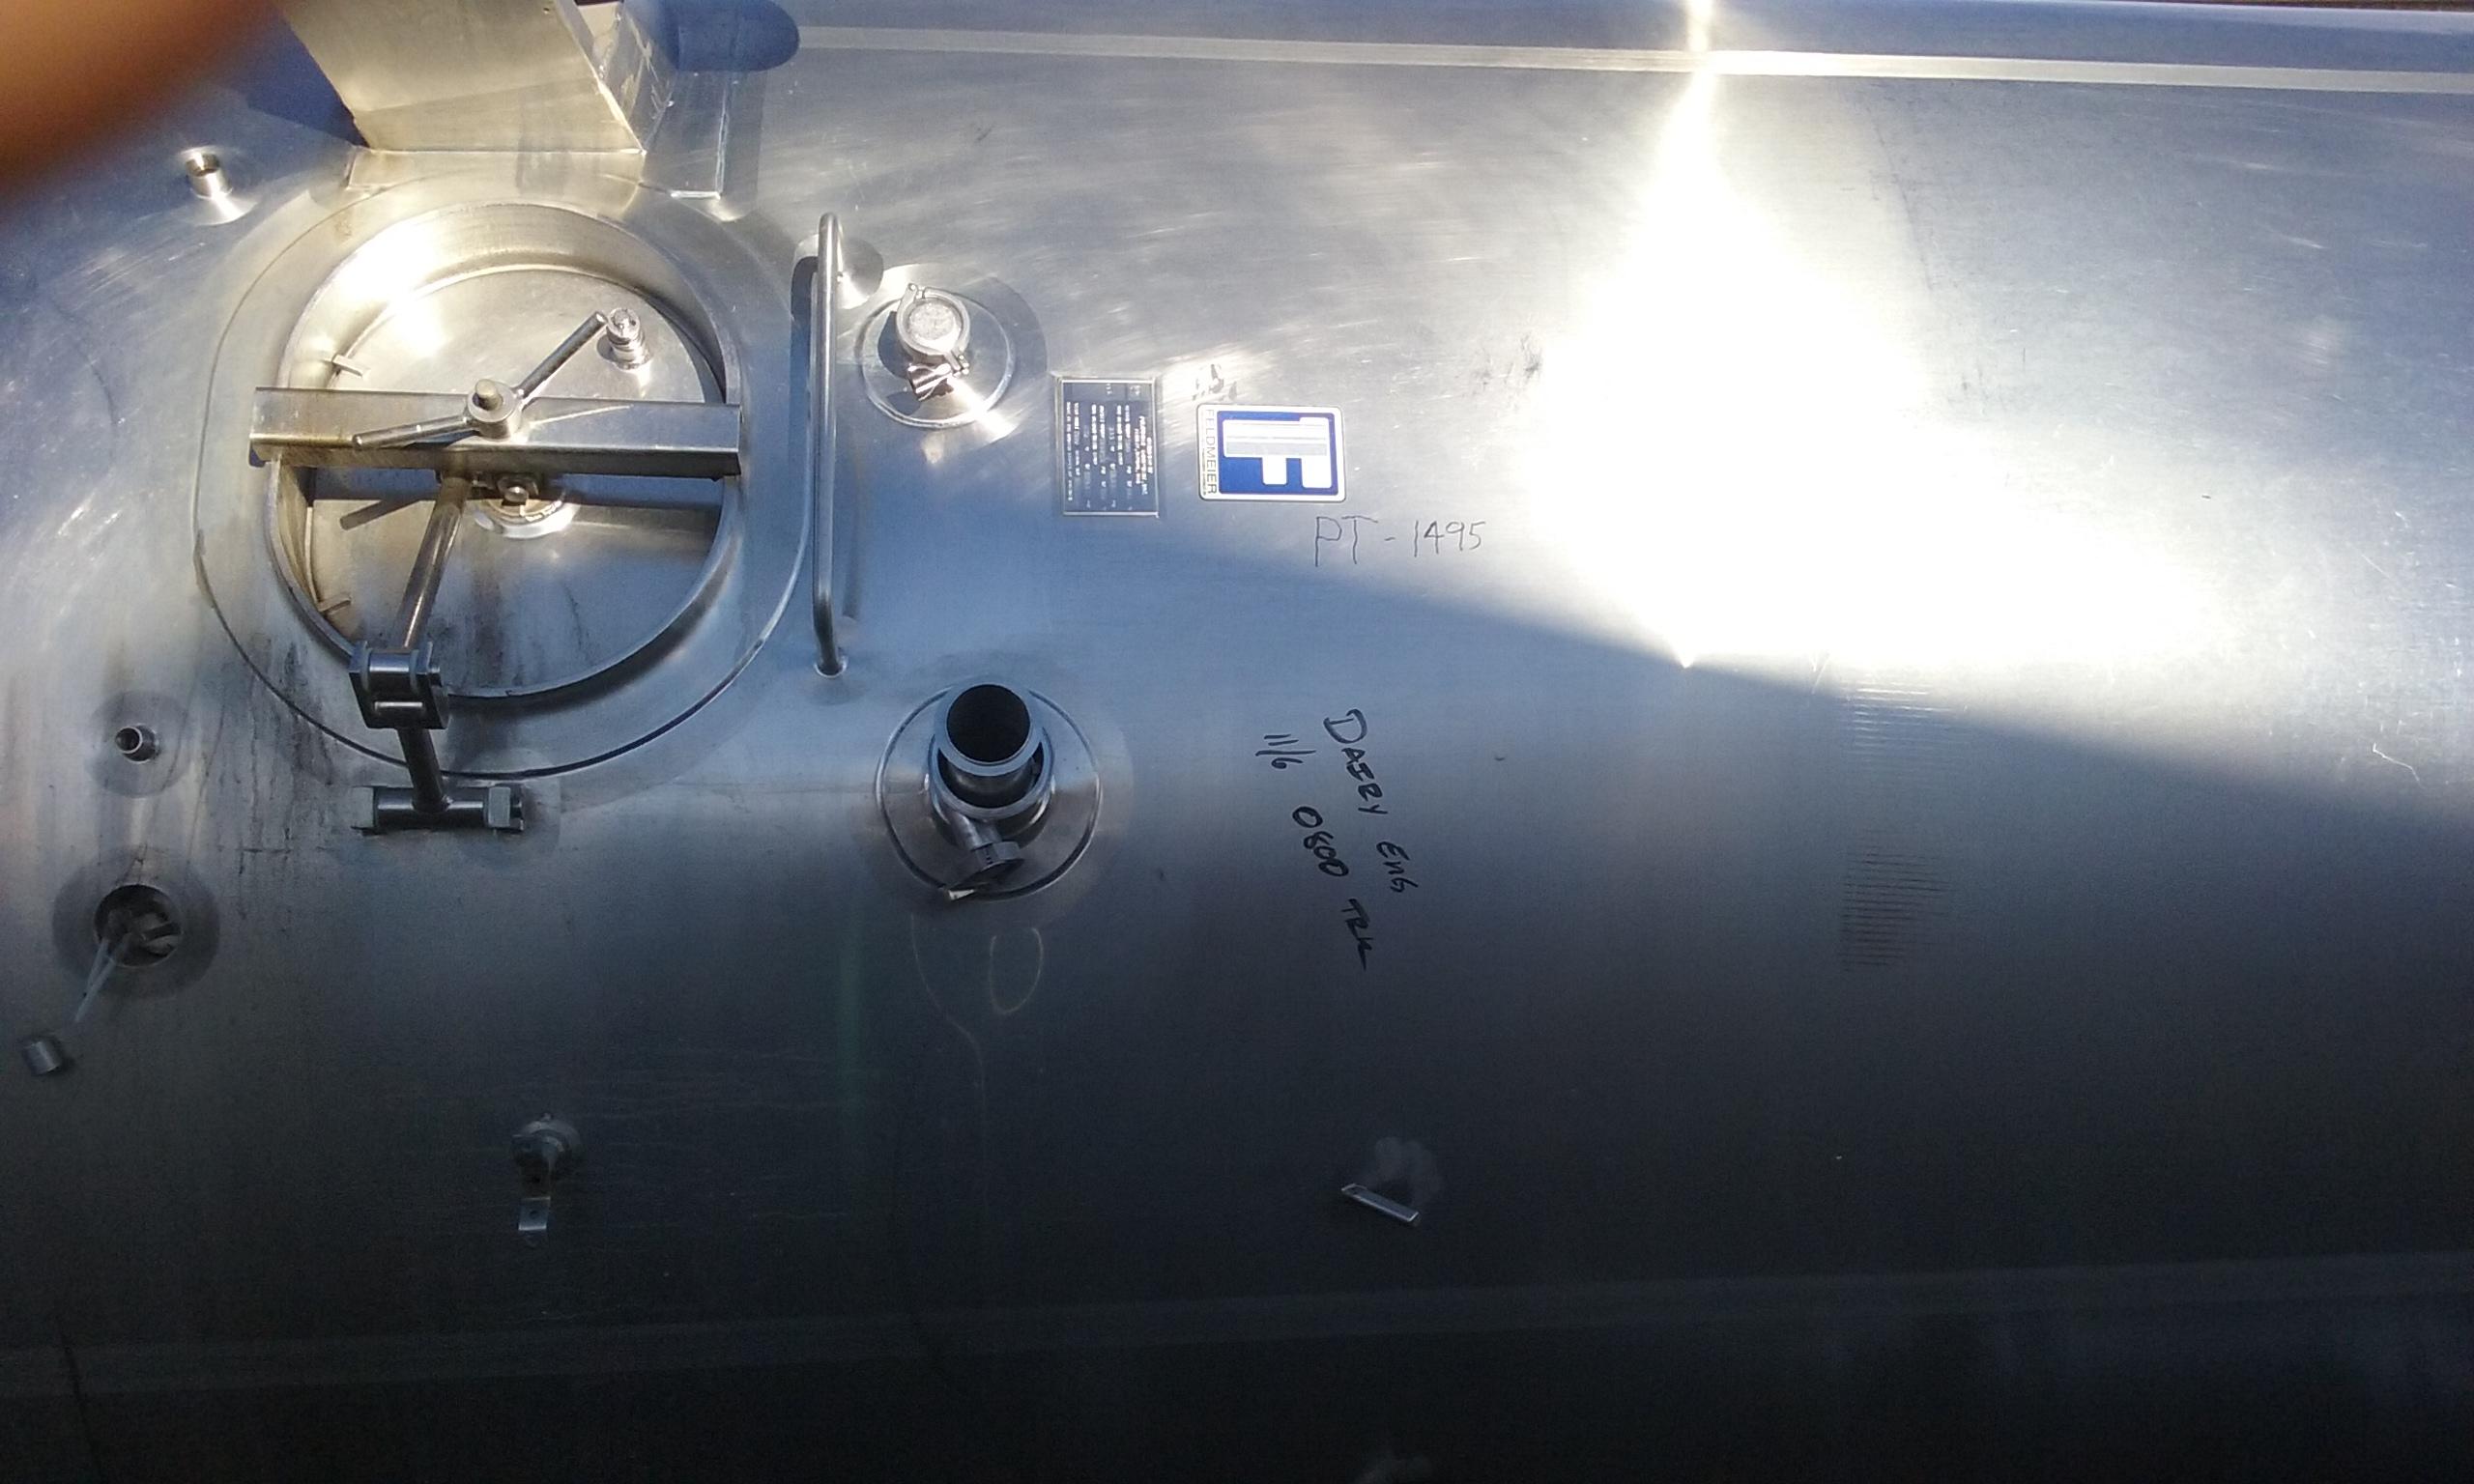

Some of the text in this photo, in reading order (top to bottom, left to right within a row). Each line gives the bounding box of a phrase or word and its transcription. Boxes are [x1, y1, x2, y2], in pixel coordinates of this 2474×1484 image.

[1206, 410, 1217, 494] FELDMEIER
[1255, 733, 1316, 770] 11/6
[1292, 806, 1349, 877] 0800
[1323, 708, 1389, 815] DAIRY
